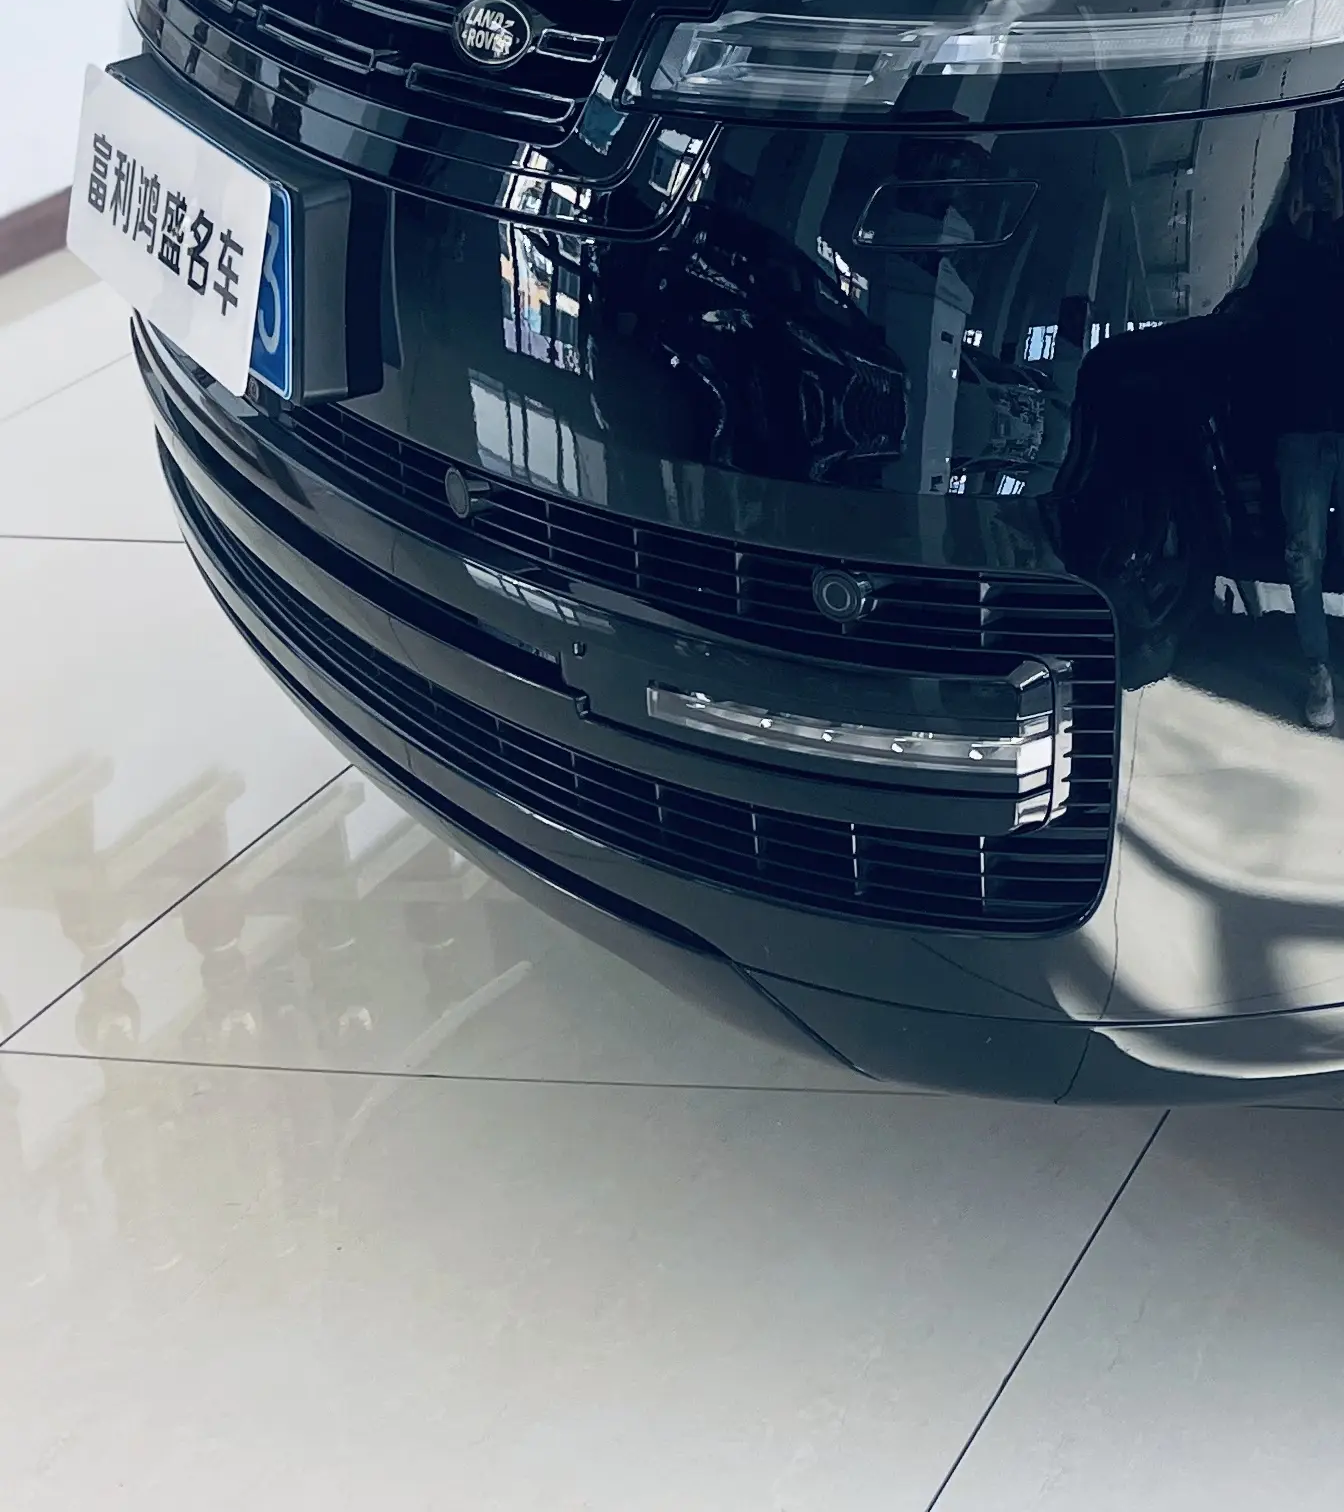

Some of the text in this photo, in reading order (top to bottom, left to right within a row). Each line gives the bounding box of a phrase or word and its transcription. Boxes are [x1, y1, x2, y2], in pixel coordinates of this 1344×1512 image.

[466, 6, 505, 29] LAND
[87, 133, 244, 317] 富利鸿盛名车
